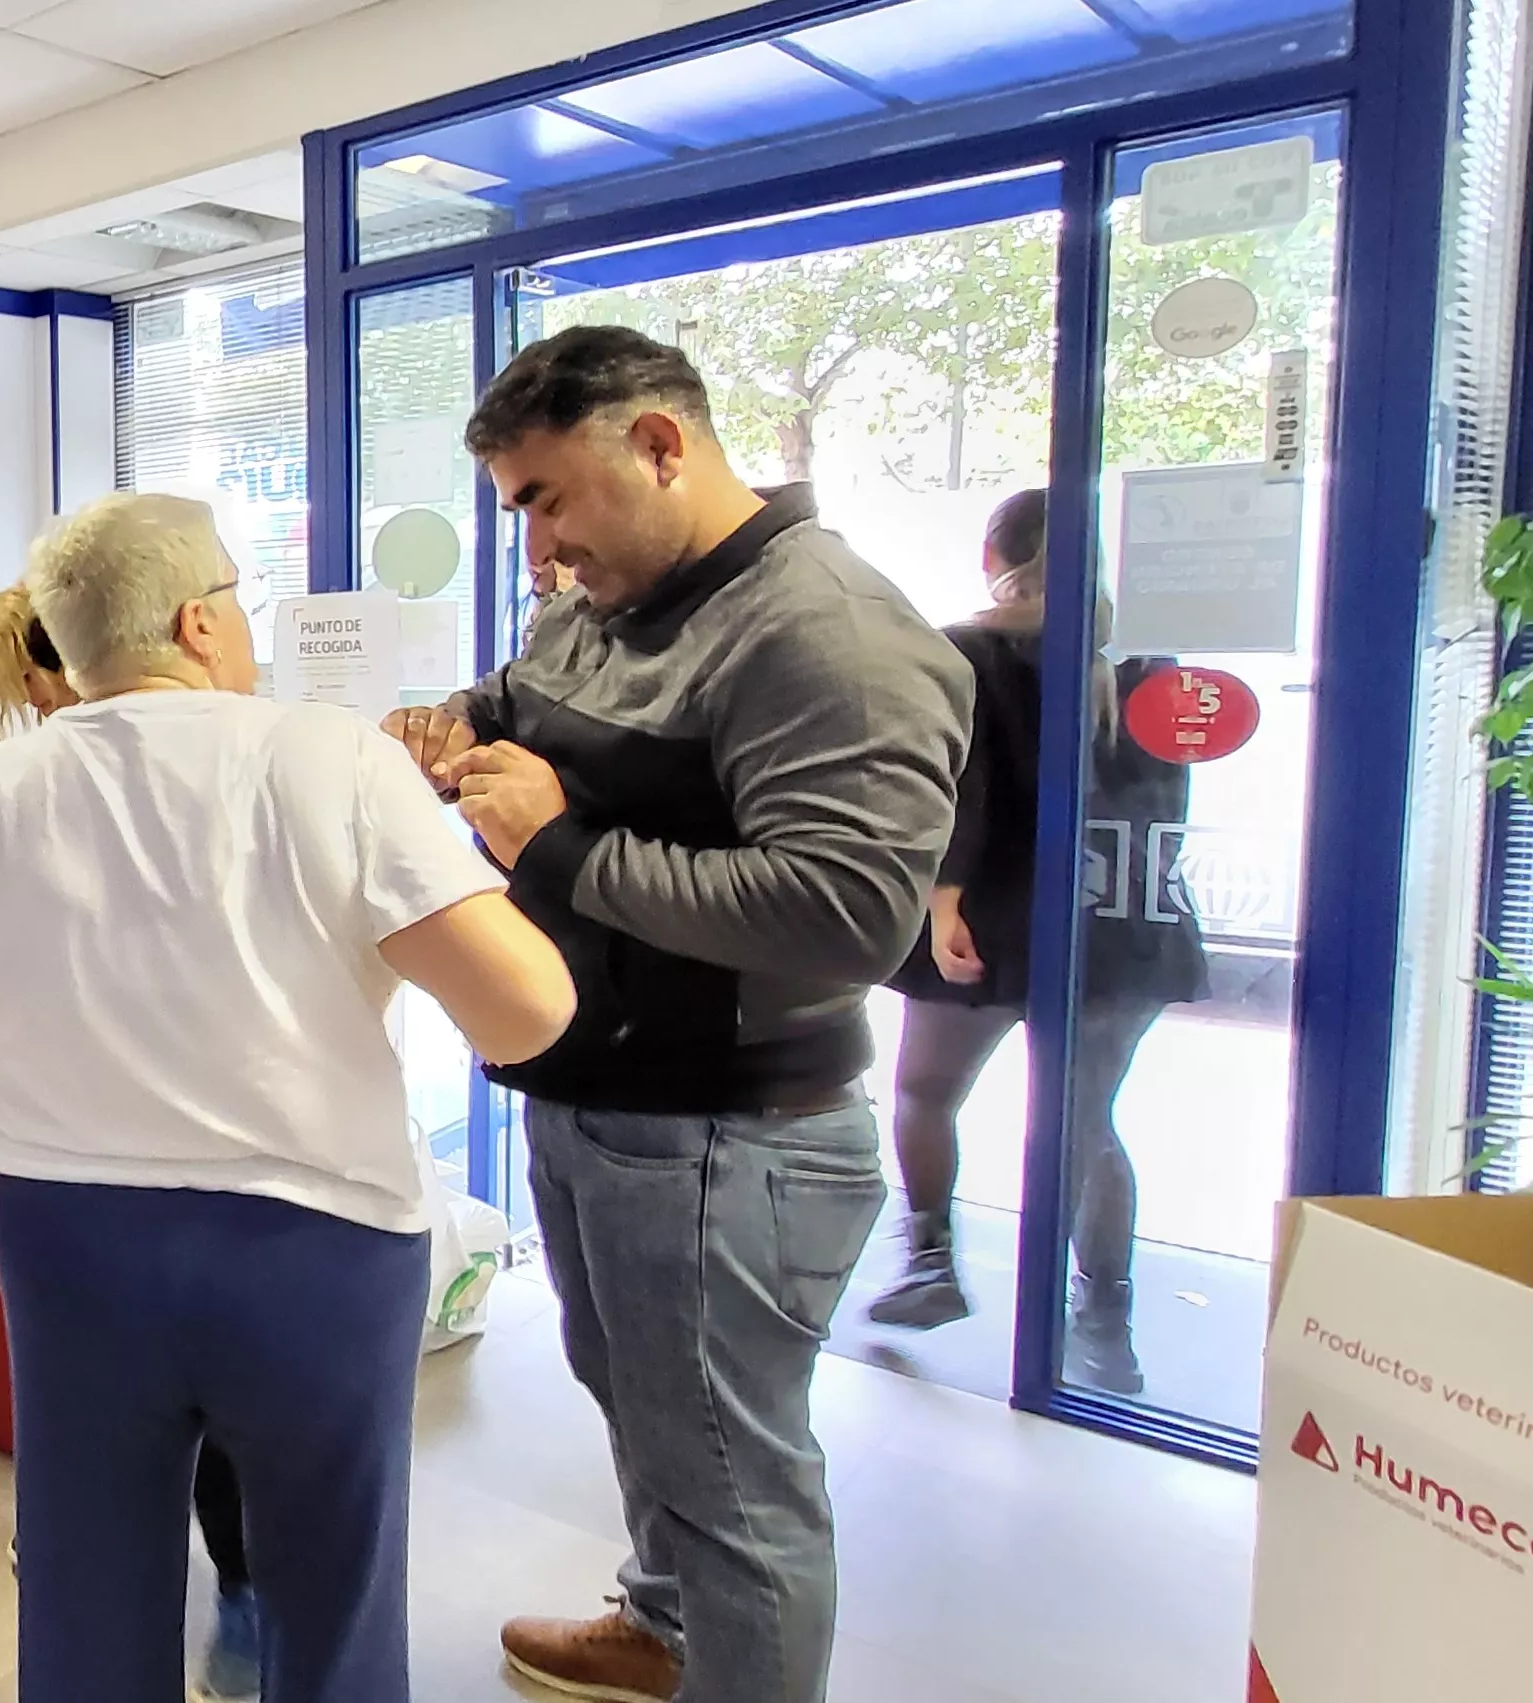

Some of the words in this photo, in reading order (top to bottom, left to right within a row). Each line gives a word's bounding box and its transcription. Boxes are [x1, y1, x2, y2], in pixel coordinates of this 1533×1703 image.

[299, 639, 362, 655] RECOGIDA
[300, 619, 344, 635] PUNTO
[345, 618, 362, 632] DE
[1303, 1317, 1433, 1394] Productos
[1355, 1433, 1533, 1556] Humec
